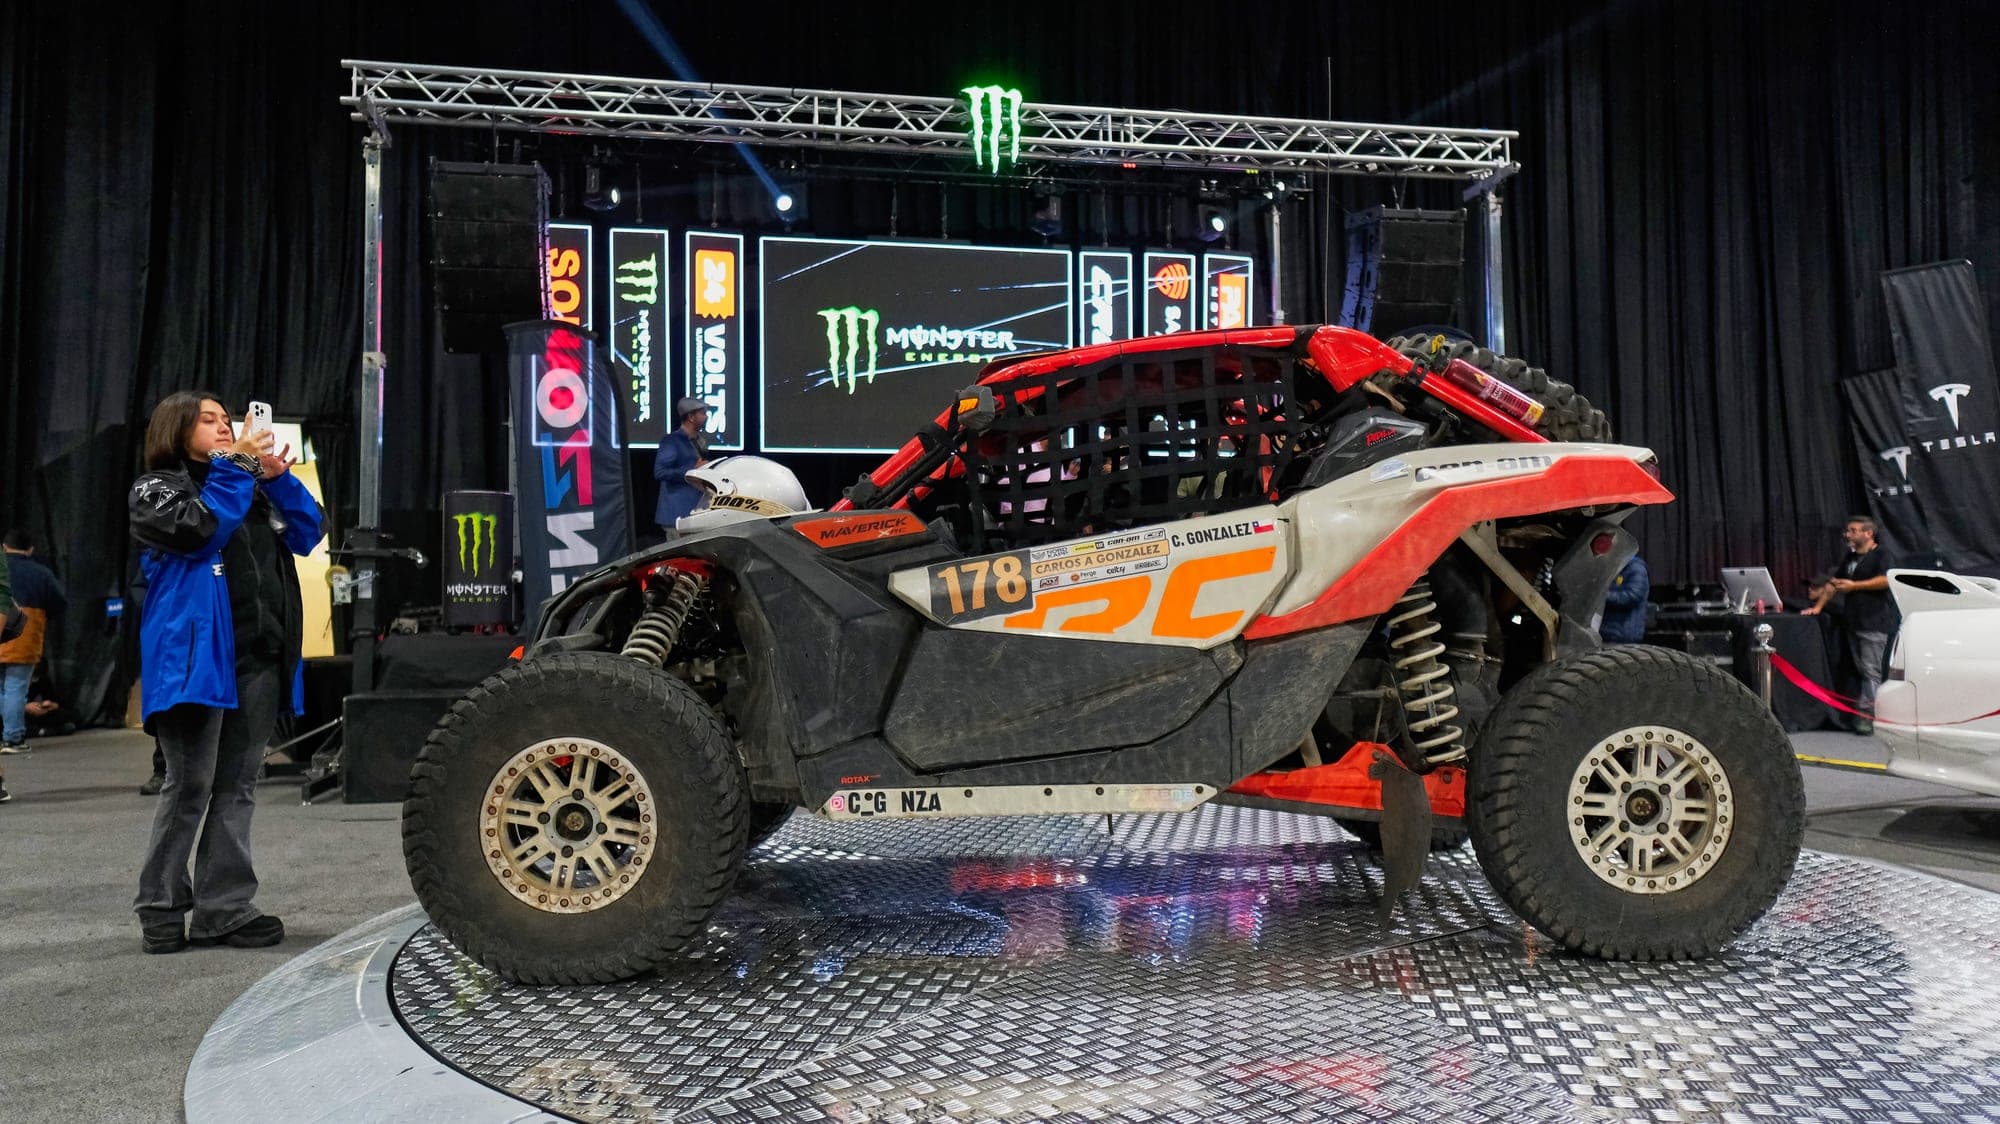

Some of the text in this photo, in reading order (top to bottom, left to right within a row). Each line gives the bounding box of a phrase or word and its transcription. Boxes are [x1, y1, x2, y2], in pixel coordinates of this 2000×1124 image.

[703, 257, 726, 304] 24
[886, 325, 1017, 351] MONSTER
[704, 323, 726, 434] VOLTS
[1920, 432, 1996, 452] TESLA
[712, 496, 761, 511] 100%
[820, 516, 907, 540] MAVERICK
[1171, 534, 1185, 548] C.
[1186, 522, 1252, 545] GONZALEZ
[1035, 558, 1081, 575] CARLOS
[1084, 556, 1094, 567] A
[1096, 544, 1161, 564] GONZALEZ
[446, 583, 508, 597] MONSTER
[937, 556, 1028, 615] 178
[841, 775, 871, 784] ROTAX
